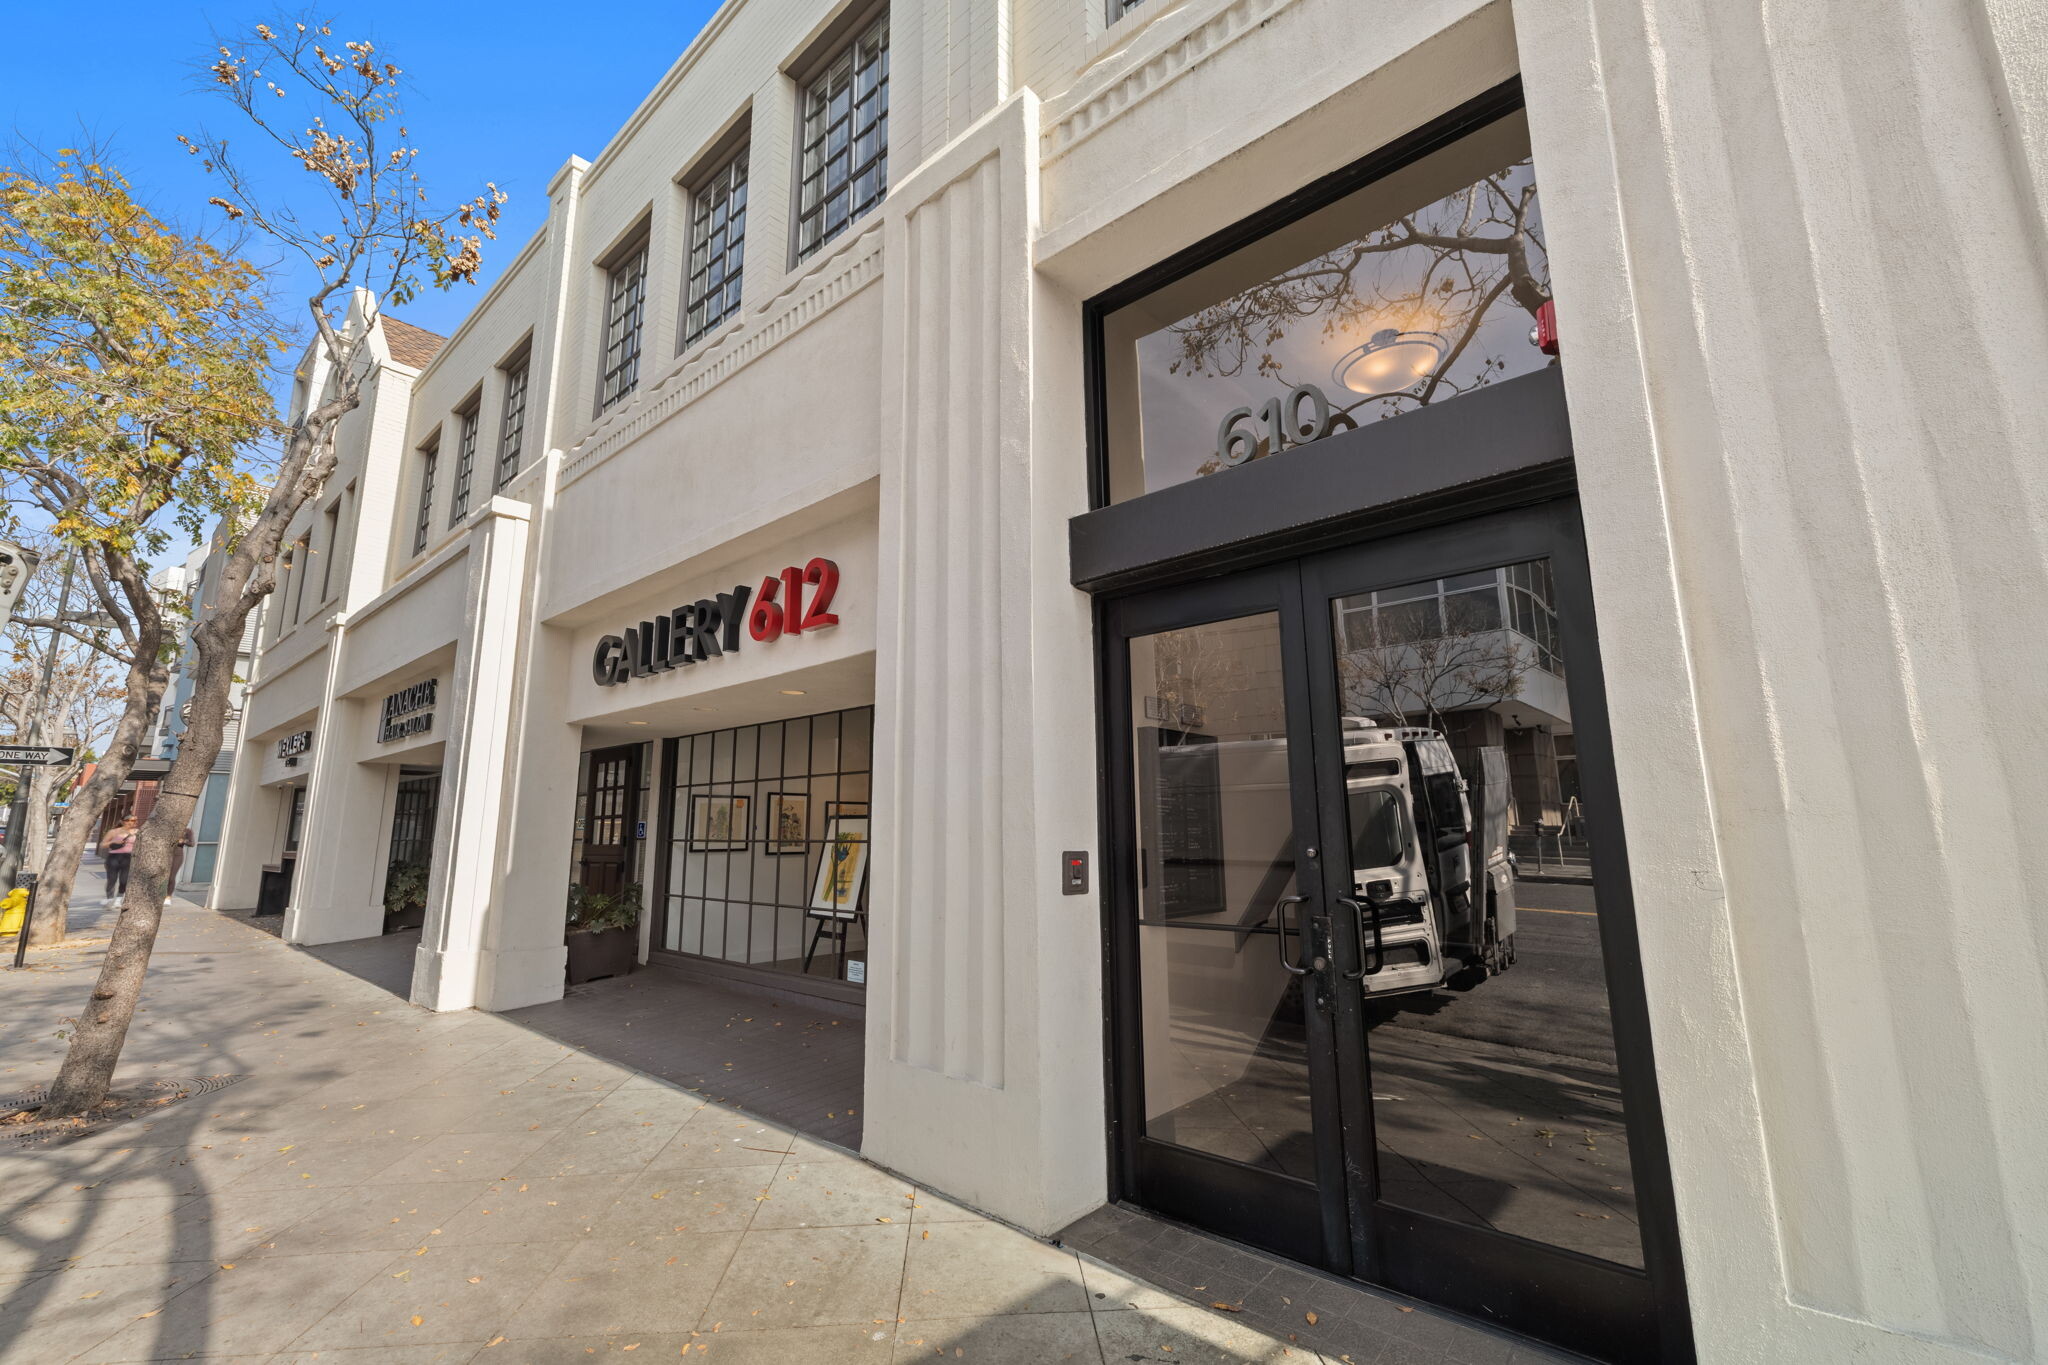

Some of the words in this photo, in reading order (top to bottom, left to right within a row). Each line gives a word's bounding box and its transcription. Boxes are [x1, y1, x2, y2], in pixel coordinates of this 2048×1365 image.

[1217, 384, 1330, 467] 610
[593, 585, 751, 687] GALLERY
[749, 557, 840, 643] 612
[0, 750, 21, 759] ONE
[25, 751, 49, 760] WAY
